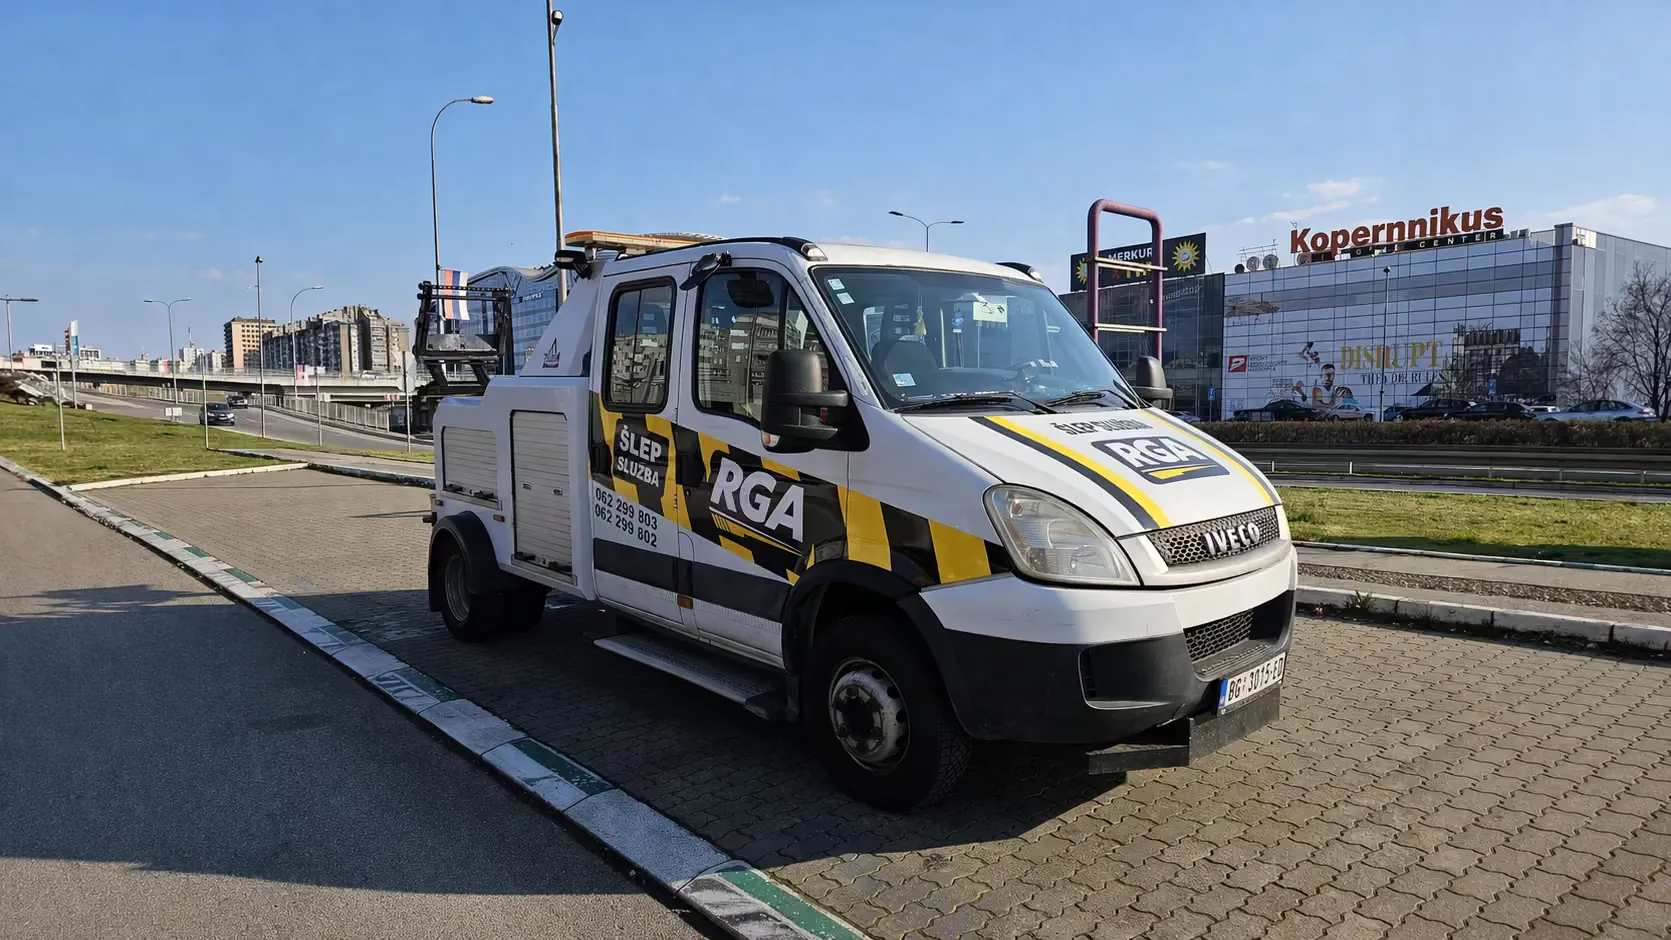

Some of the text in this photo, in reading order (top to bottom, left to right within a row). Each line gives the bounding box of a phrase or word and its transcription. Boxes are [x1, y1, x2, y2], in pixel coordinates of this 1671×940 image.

[1290, 206, 1504, 260] Kopernnikus
[1419, 232, 1497, 248] CENTER
[620, 425, 662, 463] ŠLEP
[1104, 437, 1208, 468] RGA
[596, 487, 658, 530] 062 299 803
[710, 457, 805, 543] RGA
[595, 504, 657, 547] 062 299 802
[1204, 522, 1260, 555] IVECO
